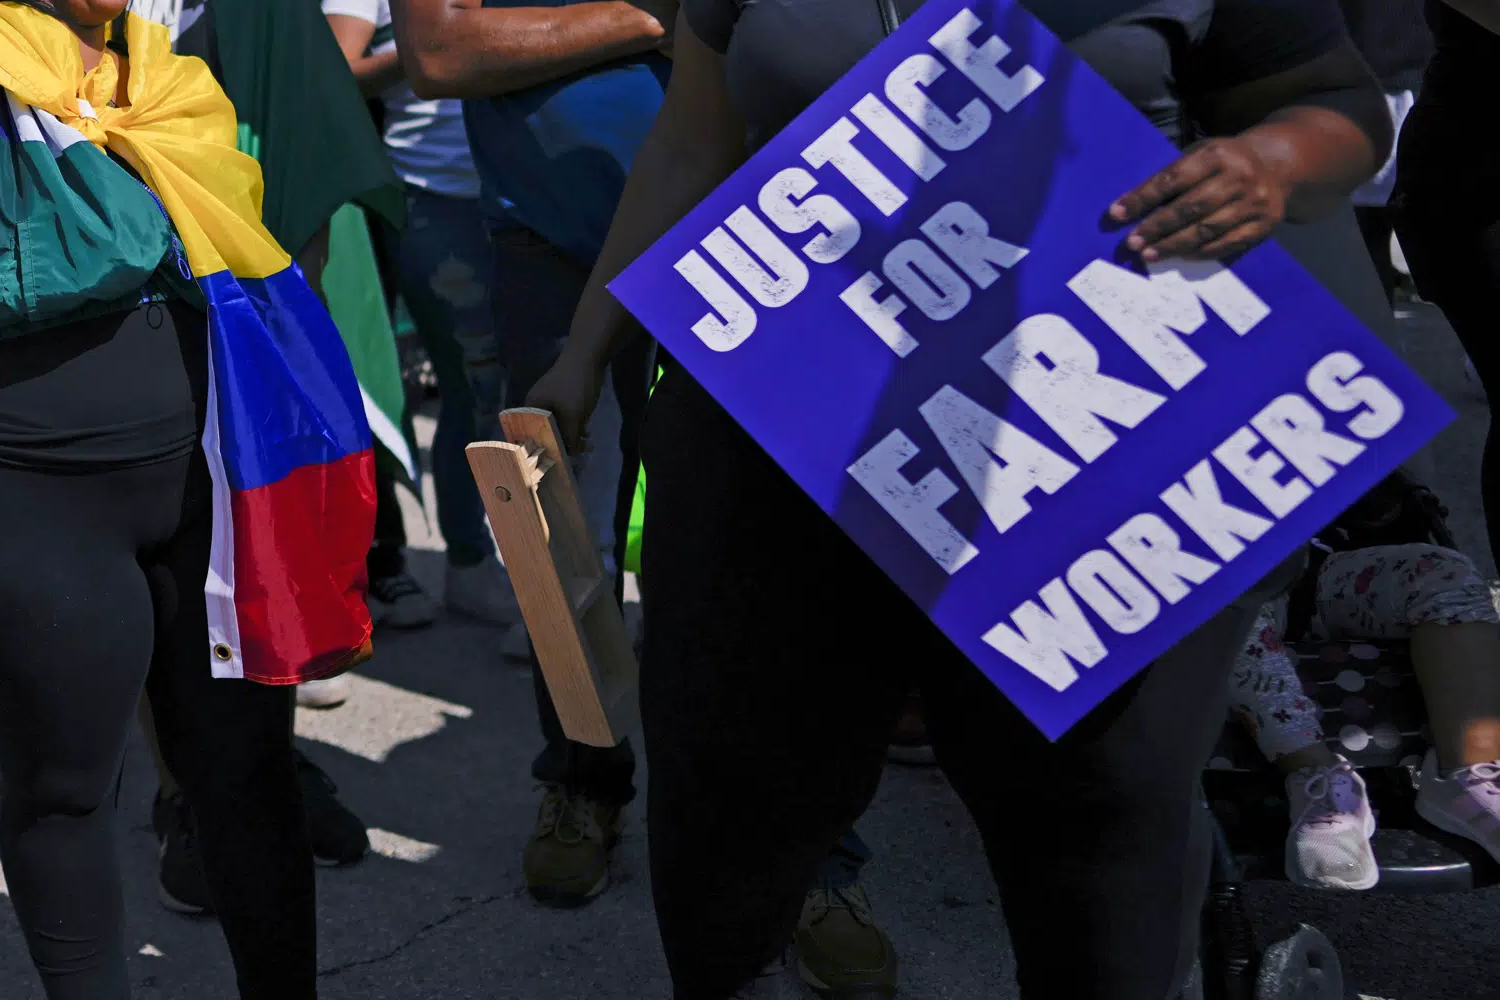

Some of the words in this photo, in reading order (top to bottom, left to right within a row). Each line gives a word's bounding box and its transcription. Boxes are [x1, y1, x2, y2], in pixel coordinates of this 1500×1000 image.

[671, 6, 1046, 354] JUSTICE
[838, 200, 1031, 359] FOR
[845, 256, 1272, 577] FARM
[981, 349, 1406, 693] WORKERS
